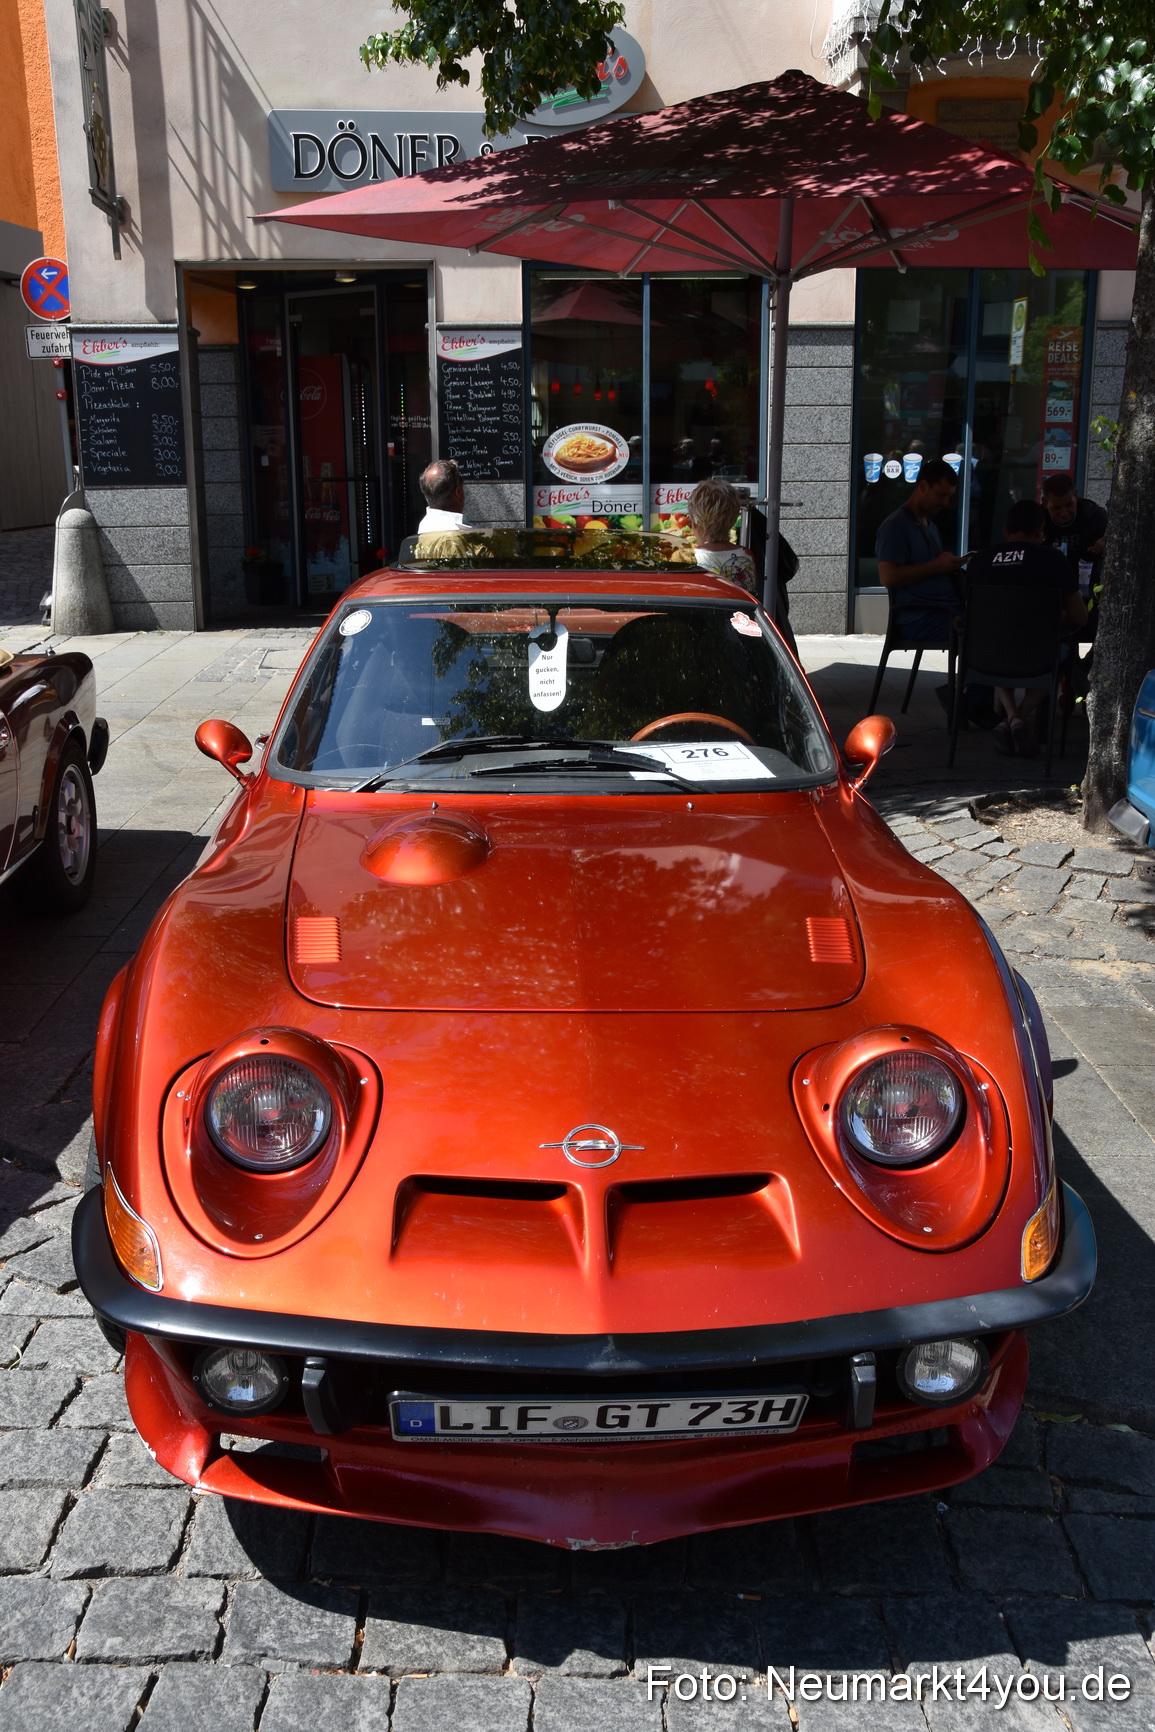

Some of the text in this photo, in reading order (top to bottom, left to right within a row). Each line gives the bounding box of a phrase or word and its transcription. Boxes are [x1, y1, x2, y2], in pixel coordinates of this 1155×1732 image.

[290, 119, 461, 182] DÖNER
[42, 343, 71, 354] zufahrt
[1048, 341, 1079, 352] REISE
[1047, 352, 1078, 363] DEALS
[80, 365, 101, 379] Pide
[1047, 406, 1072, 417] 569,-
[90, 435, 117, 445] Salami
[90, 447, 128, 461] Speciale
[1044, 453, 1063, 464] 89,-
[536, 486, 590, 508] Ekber's
[655, 487, 690, 506] Ekbe
[592, 500, 638, 513] Döner
[992, 549, 1025, 563] AZN
[535, 666, 560, 674] gucken,
[681, 747, 729, 759] 276
[440, 1398, 798, 1431] LIF GT 73H
[409, 1419, 423, 1428] D
